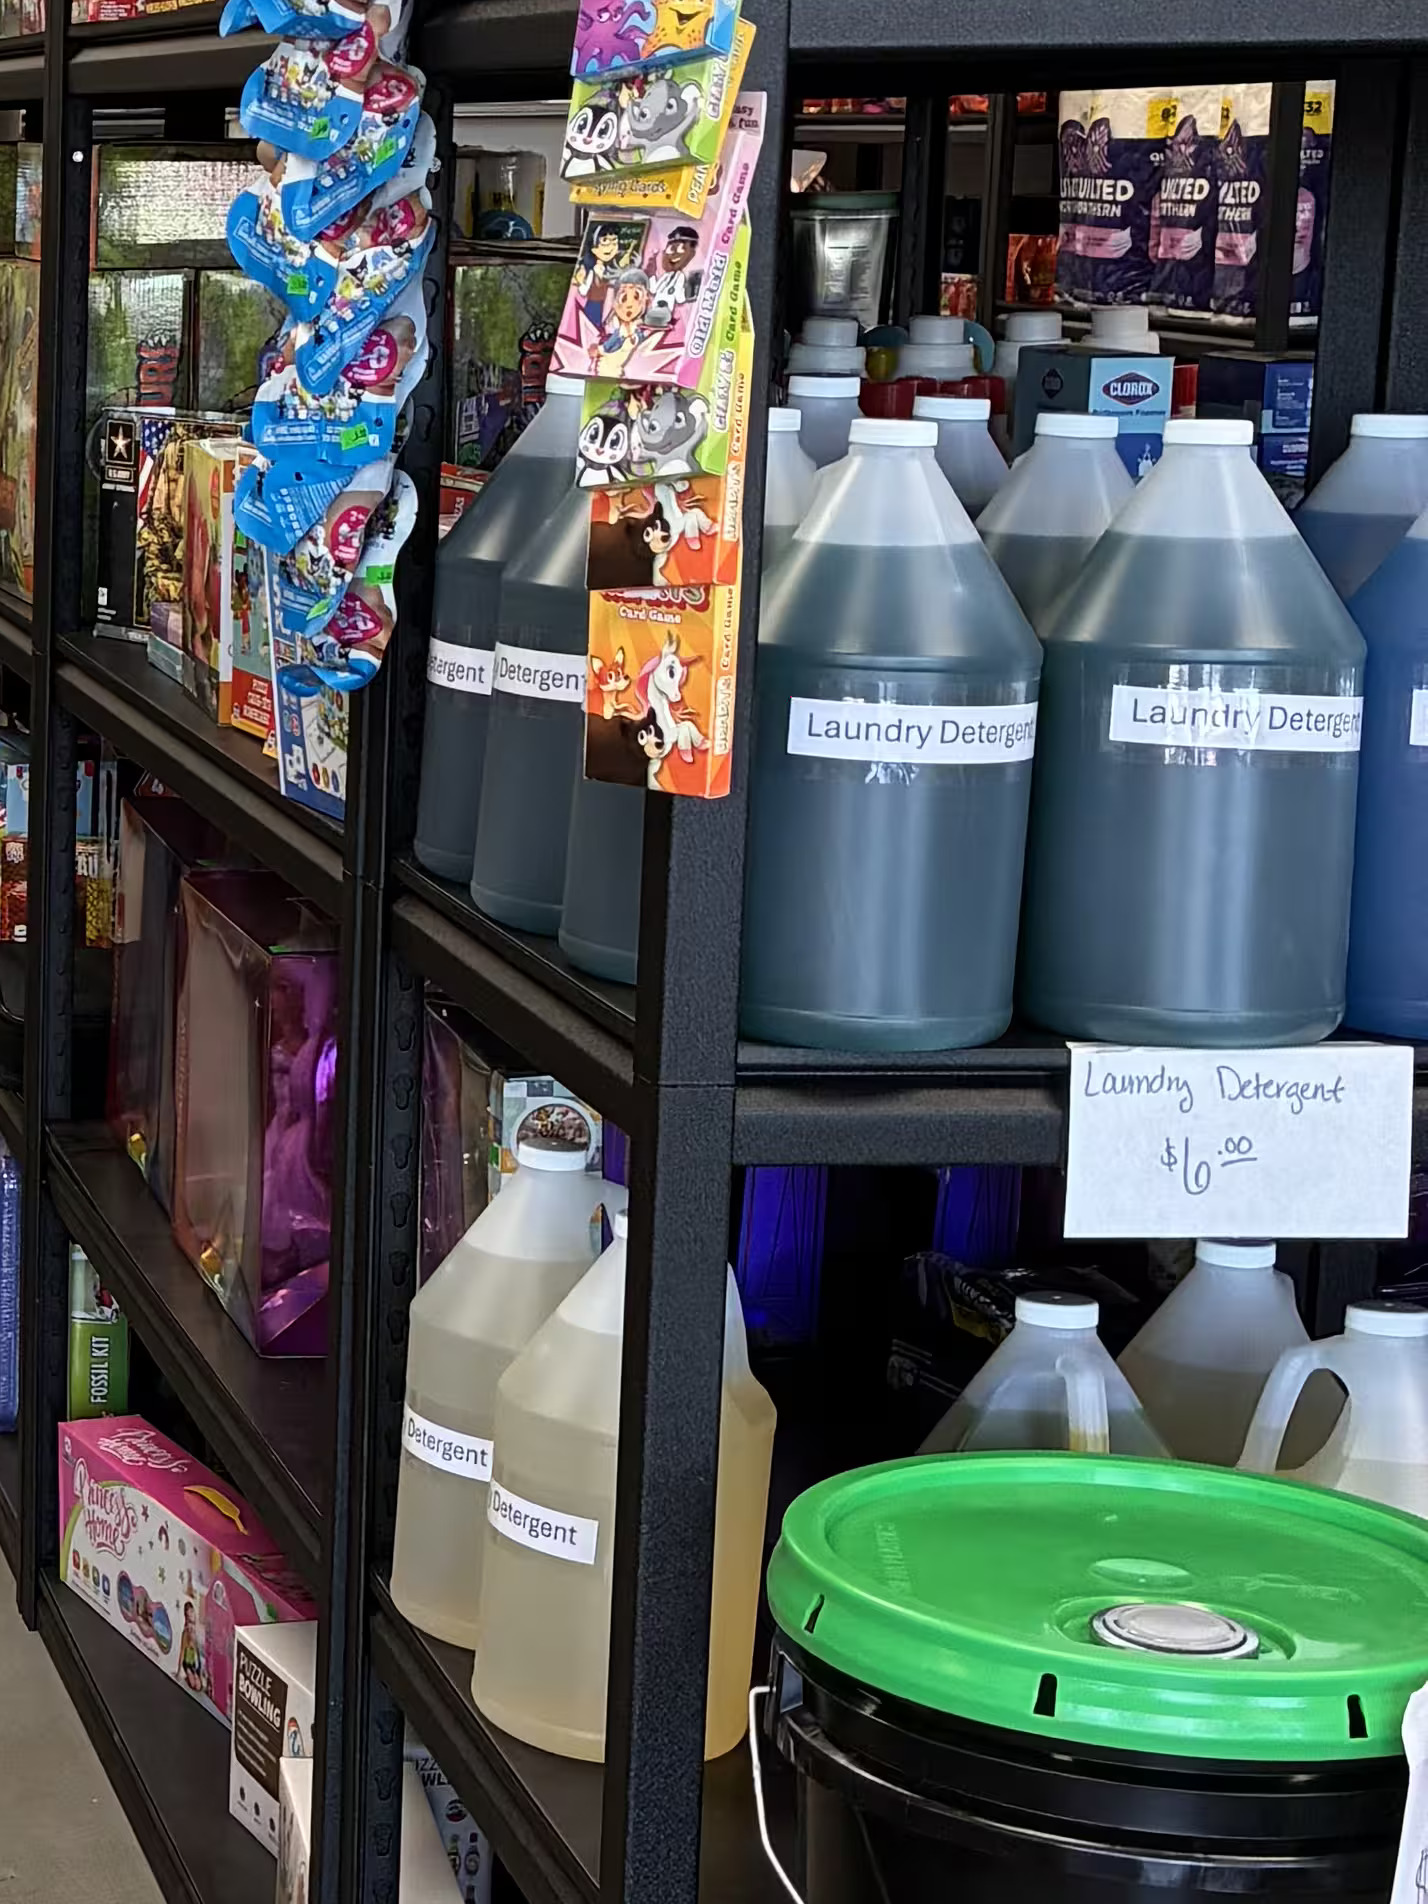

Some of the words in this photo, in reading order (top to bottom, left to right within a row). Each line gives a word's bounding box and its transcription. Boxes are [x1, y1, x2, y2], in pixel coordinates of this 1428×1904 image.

[690, 316, 709, 358] Old
[701, 252, 728, 316] Maid
[722, 208, 737, 244] Card
[733, 163, 749, 202] Game
[731, 261, 742, 301] Game
[726, 305, 738, 342] Card
[735, 372, 746, 416] Game
[1109, 381, 1155, 397] CLOROX
[731, 418, 742, 455] Card
[619, 606, 644, 620] Card
[647, 610, 682, 624] Game
[722, 634, 733, 671] Card
[806, 712, 933, 749] Laundry
[1131, 698, 1260, 737] Laundry
[1083, 1065, 1194, 1114] Laundry
[1216, 1065, 1346, 1116] Detergent
[91, 1336, 109, 1359] KIT
[90, 1362, 109, 1404] FOSSIL
[407, 1418, 490, 1469] Detergent
[490, 1490, 579, 1548] Detergent
[239, 1652, 273, 1694] PUZZLE
[238, 1673, 281, 1728] BOWLING
